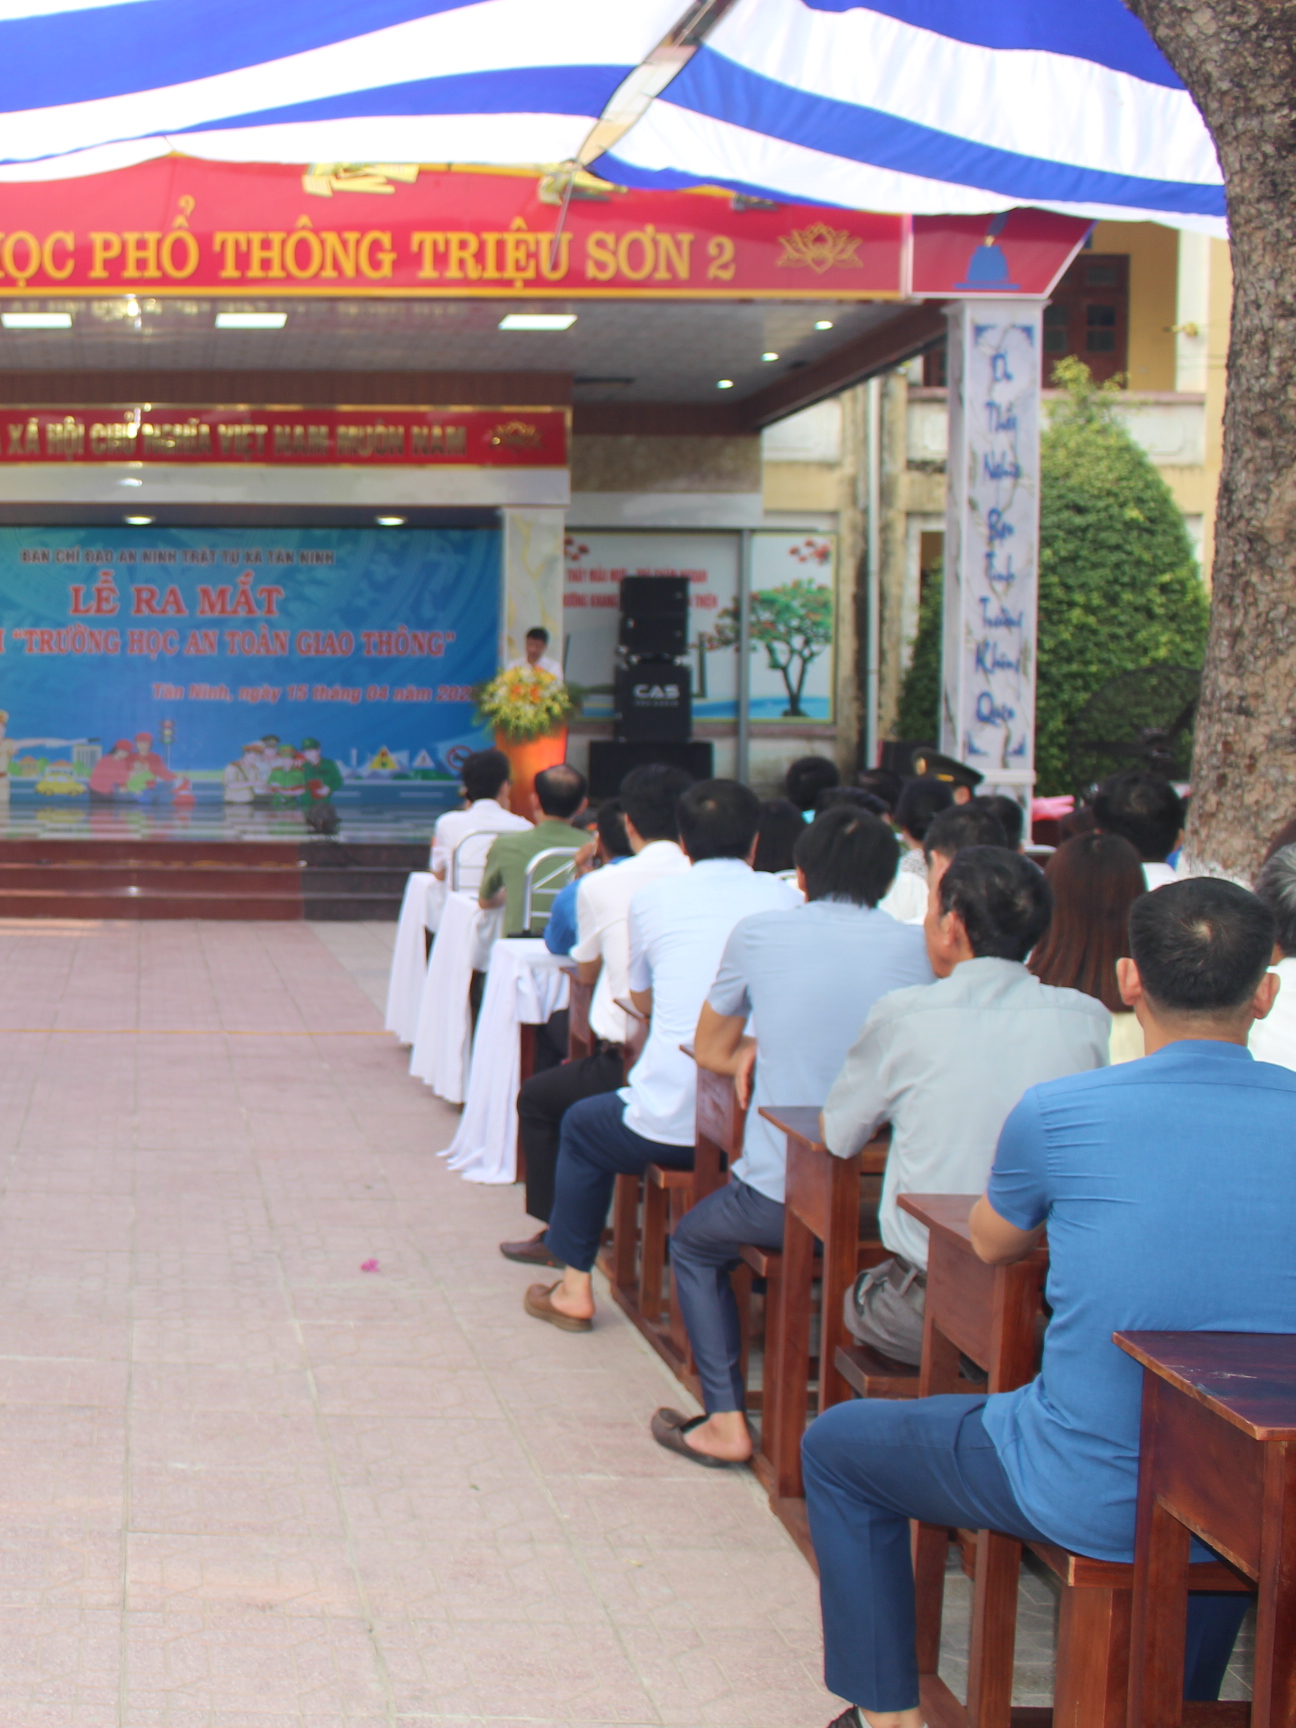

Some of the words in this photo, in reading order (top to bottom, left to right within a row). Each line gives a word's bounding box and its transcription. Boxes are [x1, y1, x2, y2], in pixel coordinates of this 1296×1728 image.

[88, 195, 200, 281] PHỔ
[213, 214, 397, 281] THÔNG
[410, 216, 572, 289] TRIỆU
[585, 223, 695, 281] SƠN
[707, 236, 736, 281] 2
[217, 417, 268, 461] VIỆT
[273, 424, 329, 455] NAM
[21, 549, 50, 563] BAN
[55, 545, 80, 563] CHÍ
[84, 549, 114, 565] ĐẠO
[118, 550, 137, 563] AN
[142, 550, 177, 563] NINH
[267, 548, 295, 564] TÂN
[299, 550, 335, 565] NINH
[69, 570, 119, 615] LỄ
[131, 585, 188, 616] RA
[197, 570, 285, 616] MẮT
[127, 629, 179, 660] HỌC
[183, 630, 219, 655] AN
[225, 624, 289, 656] TOÀN
[296, 631, 354, 656] GIAO
[153, 684, 185, 700] Tân
[239, 684, 281, 704] ngày
[287, 684, 309, 700] 15
[312, 684, 362, 704] tháng
[366, 685, 390, 700] 04
[394, 684, 433, 701] năm
[436, 685, 480, 702] 202
[633, 684, 680, 699] CAS
